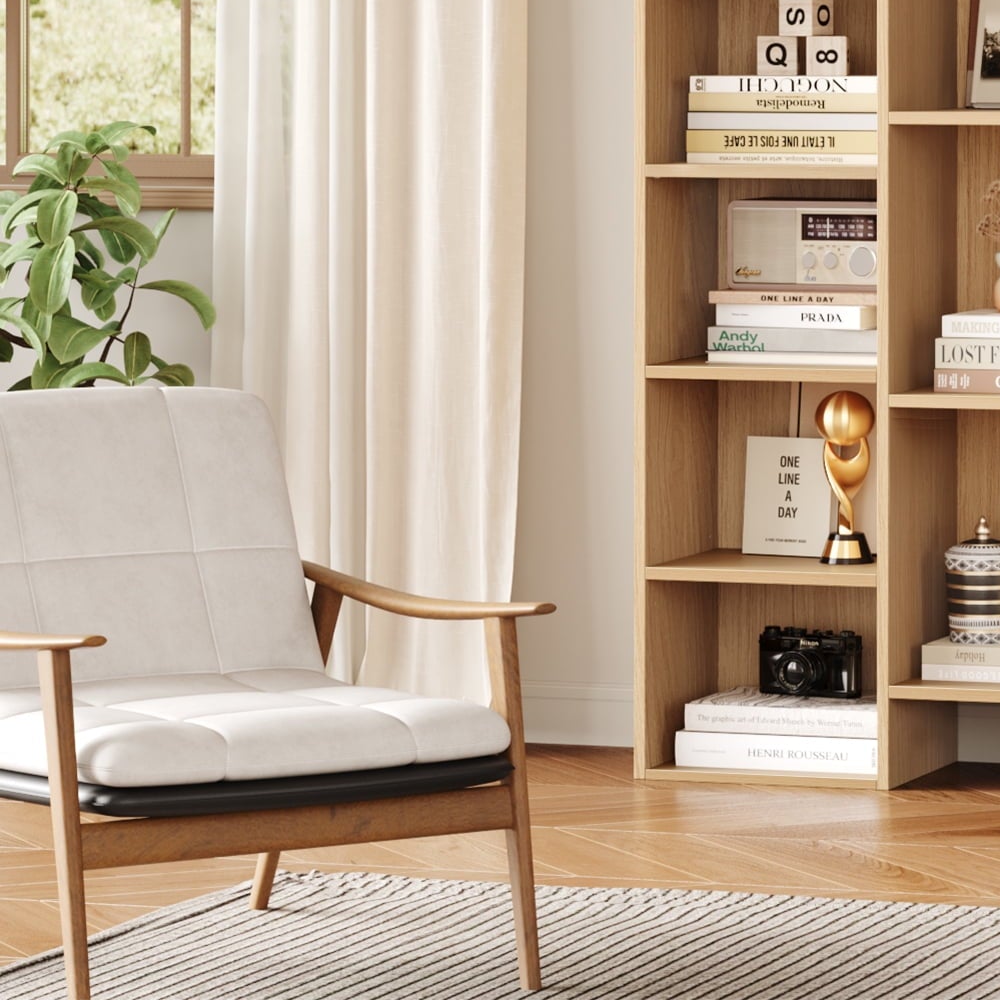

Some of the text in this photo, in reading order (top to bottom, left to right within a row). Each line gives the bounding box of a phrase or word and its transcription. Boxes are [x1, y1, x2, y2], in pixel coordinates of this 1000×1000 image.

[786, 7, 805, 25] S
[765, 43, 787, 66] Q
[816, 49, 838, 64] 8
[739, 77, 848, 93] NOGUCHI
[756, 98, 826, 110] Remodelista
[723, 135, 835, 150] IL ÉTAIT UNE FOIS LE CAFÉ
[800, 312, 842, 323] PRADA
[951, 321, 1000, 334] MAKING
[719, 330, 758, 344] Andy
[713, 342, 765, 352] Warhol
[941, 344, 986, 364] LOST
[779, 455, 800, 468] ONE
[778, 472, 800, 486] LINE
[784, 490, 792, 502] A
[777, 506, 798, 519] DAY
[955, 650, 986, 662] Holiday
[697, 713, 710, 721] The
[711, 713, 735, 724] graphic
[807, 717, 815, 727] by
[747, 748, 848, 761] HENRI ROUSSEAU
